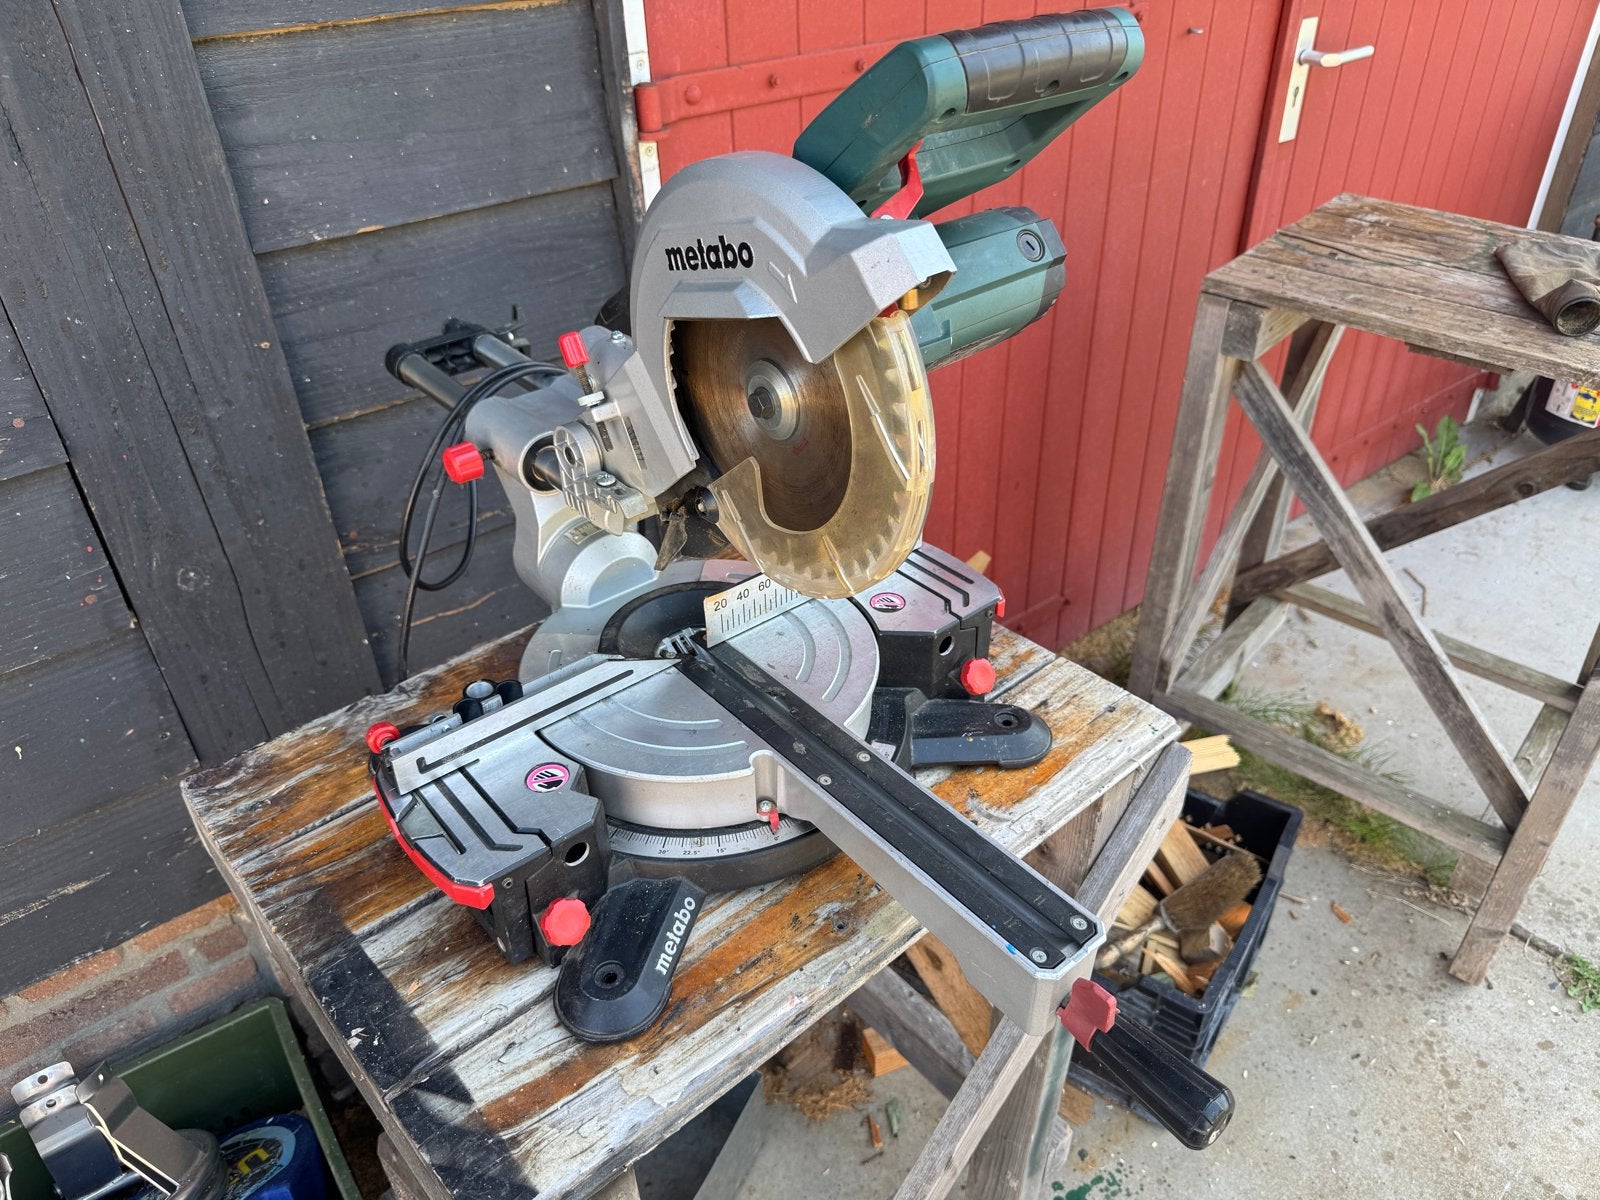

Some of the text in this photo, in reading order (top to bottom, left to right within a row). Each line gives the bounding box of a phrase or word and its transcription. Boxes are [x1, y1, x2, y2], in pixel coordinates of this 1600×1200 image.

[665, 235, 755, 271] metabo
[713, 578, 771, 612] 20 40 60
[654, 896, 696, 976] metabo
